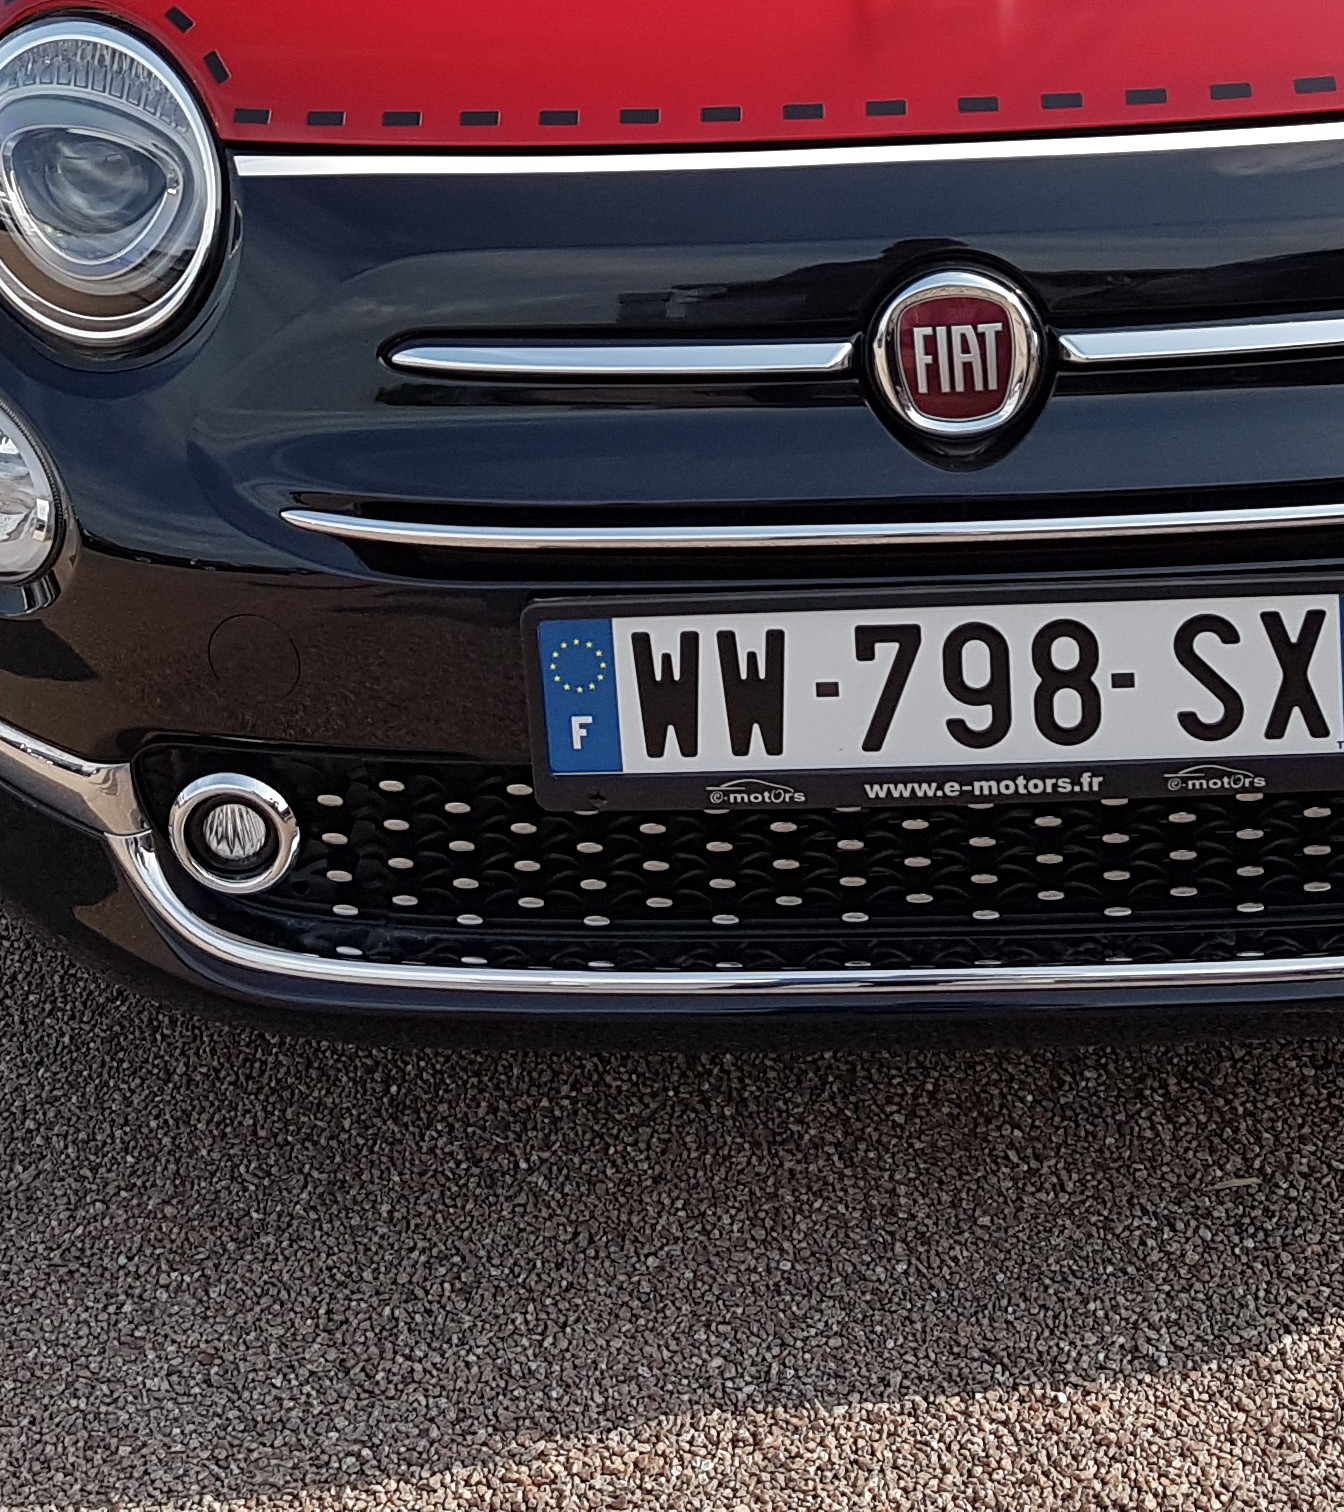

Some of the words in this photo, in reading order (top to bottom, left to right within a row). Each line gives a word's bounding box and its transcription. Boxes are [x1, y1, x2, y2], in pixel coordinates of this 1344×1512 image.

[913, 323, 1003, 394] FIAT
[570, 715, 594, 750] F
[708, 788, 806, 804] e-motors
[864, 772, 1104, 800] www.e-motors.fr
[1167, 774, 1267, 791] e-motors
